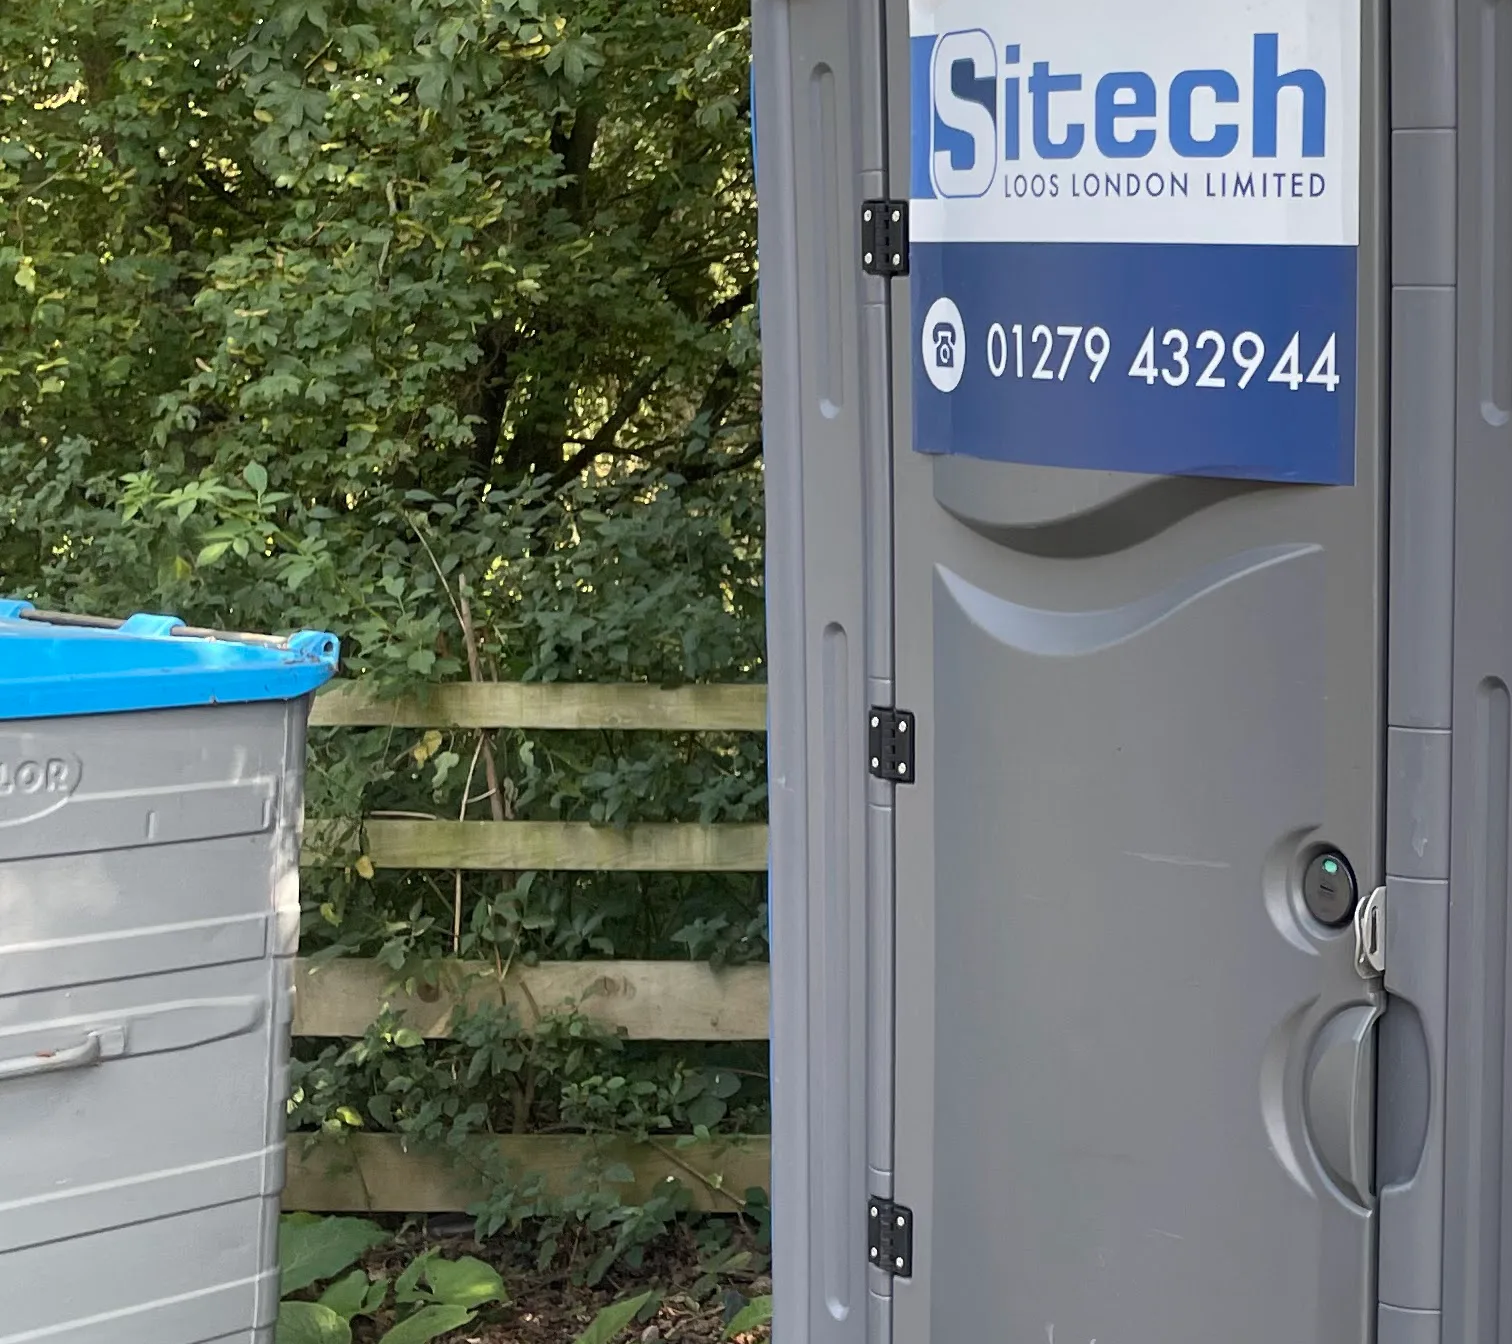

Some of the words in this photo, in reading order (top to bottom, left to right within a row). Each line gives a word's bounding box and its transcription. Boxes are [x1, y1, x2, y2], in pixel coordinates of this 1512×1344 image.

[932, 29, 1326, 198] Sitech
[1004, 173, 1059, 198] LOOS
[1072, 172, 1188, 197] LONDON
[1206, 172, 1326, 197] LIMITED
[987, 322, 1111, 382] 01279
[1128, 327, 1340, 391] 432944
